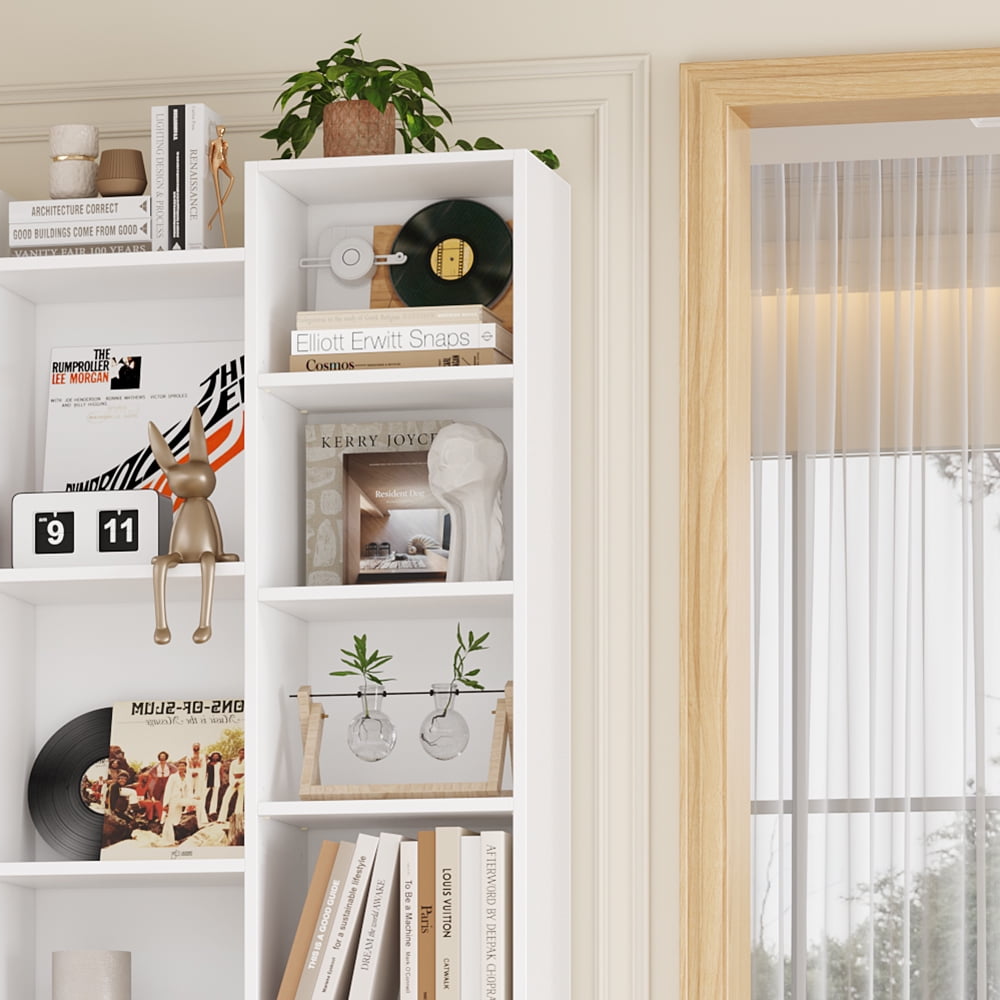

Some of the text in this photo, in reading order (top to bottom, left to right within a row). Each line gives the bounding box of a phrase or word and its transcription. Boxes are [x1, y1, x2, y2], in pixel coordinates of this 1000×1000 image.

[155, 113, 165, 155] LIGHTING
[155, 157, 165, 189] DESIGN
[190, 149, 199, 221] RENAISSANCE
[31, 202, 119, 217] ARCHITECTURE CORRECT
[155, 200, 165, 239] PROCESS
[13, 223, 138, 240] GOOD BUILDINGS COME FROM GOOD
[109, 244, 147, 254] YEARS
[296, 328, 471, 353] Elliott Erwitt Snaps
[52, 359, 110, 373] RUMPROLLER
[93, 348, 111, 359] THE
[306, 358, 355, 372] Cosmos
[52, 371, 110, 385] LEE MORGAN
[321, 435, 378, 449] KERRY
[375, 489, 408, 499] Resident
[47, 520, 65, 545] 9
[104, 518, 133, 543] 11
[405, 880, 413, 889] To
[486, 844, 496, 905] AFTERWORD
[332, 938, 342, 950] for
[339, 887, 358, 929] sustainable
[351, 855, 367, 886] lifestyle
[405, 892, 413, 903] Be
[442, 868, 452, 938] LOUIS VUITTON
[307, 880, 340, 970] THIS IS A GOOD GUIDE
[360, 879, 386, 971] DREAM AWAKE
[420, 904, 433, 934] Paris
[486, 908, 496, 921] BY
[404, 912, 412, 947] Machine
[486, 923, 496, 961] DEEPAK
